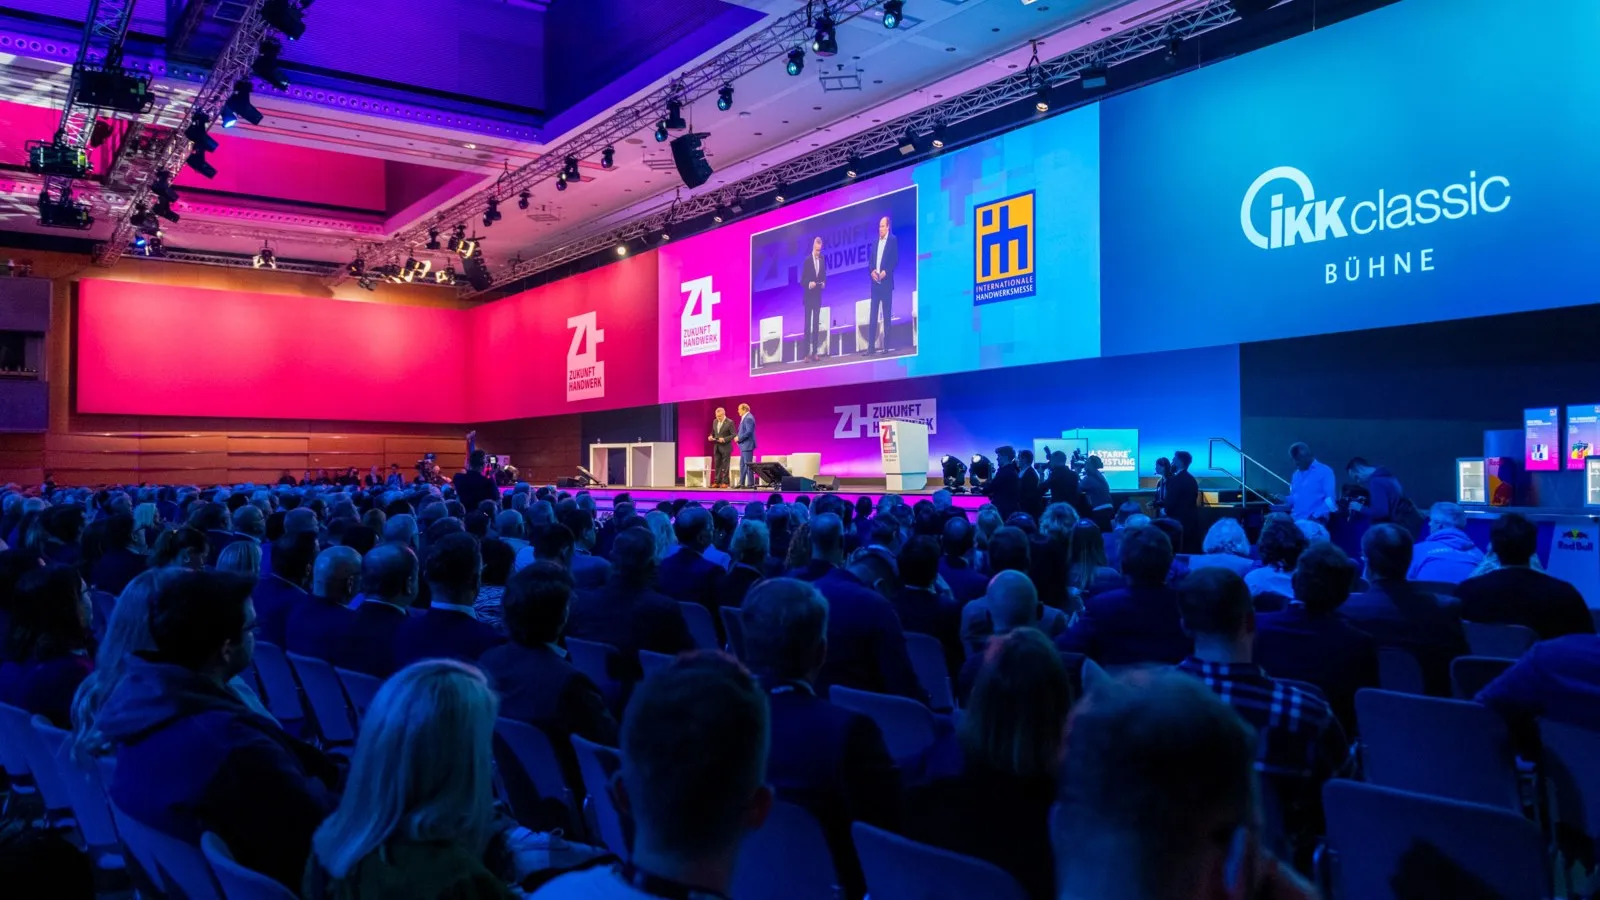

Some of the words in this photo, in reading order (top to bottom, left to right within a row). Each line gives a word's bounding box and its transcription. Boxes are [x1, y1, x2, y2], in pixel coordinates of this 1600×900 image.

[1350, 170, 1511, 235] classic
[1325, 248, 1435, 284] BÜHNE
[976, 276, 1033, 293] INTERNATIONALE
[976, 285, 1033, 301] HANDWERKSMESSE
[684, 324, 711, 338] ZUKUNFT
[684, 334, 717, 347] HANDWERK
[569, 366, 595, 380] ZUKUNFT
[569, 376, 602, 391] HANDWERK
[873, 403, 921, 418] ZUKUNFT
